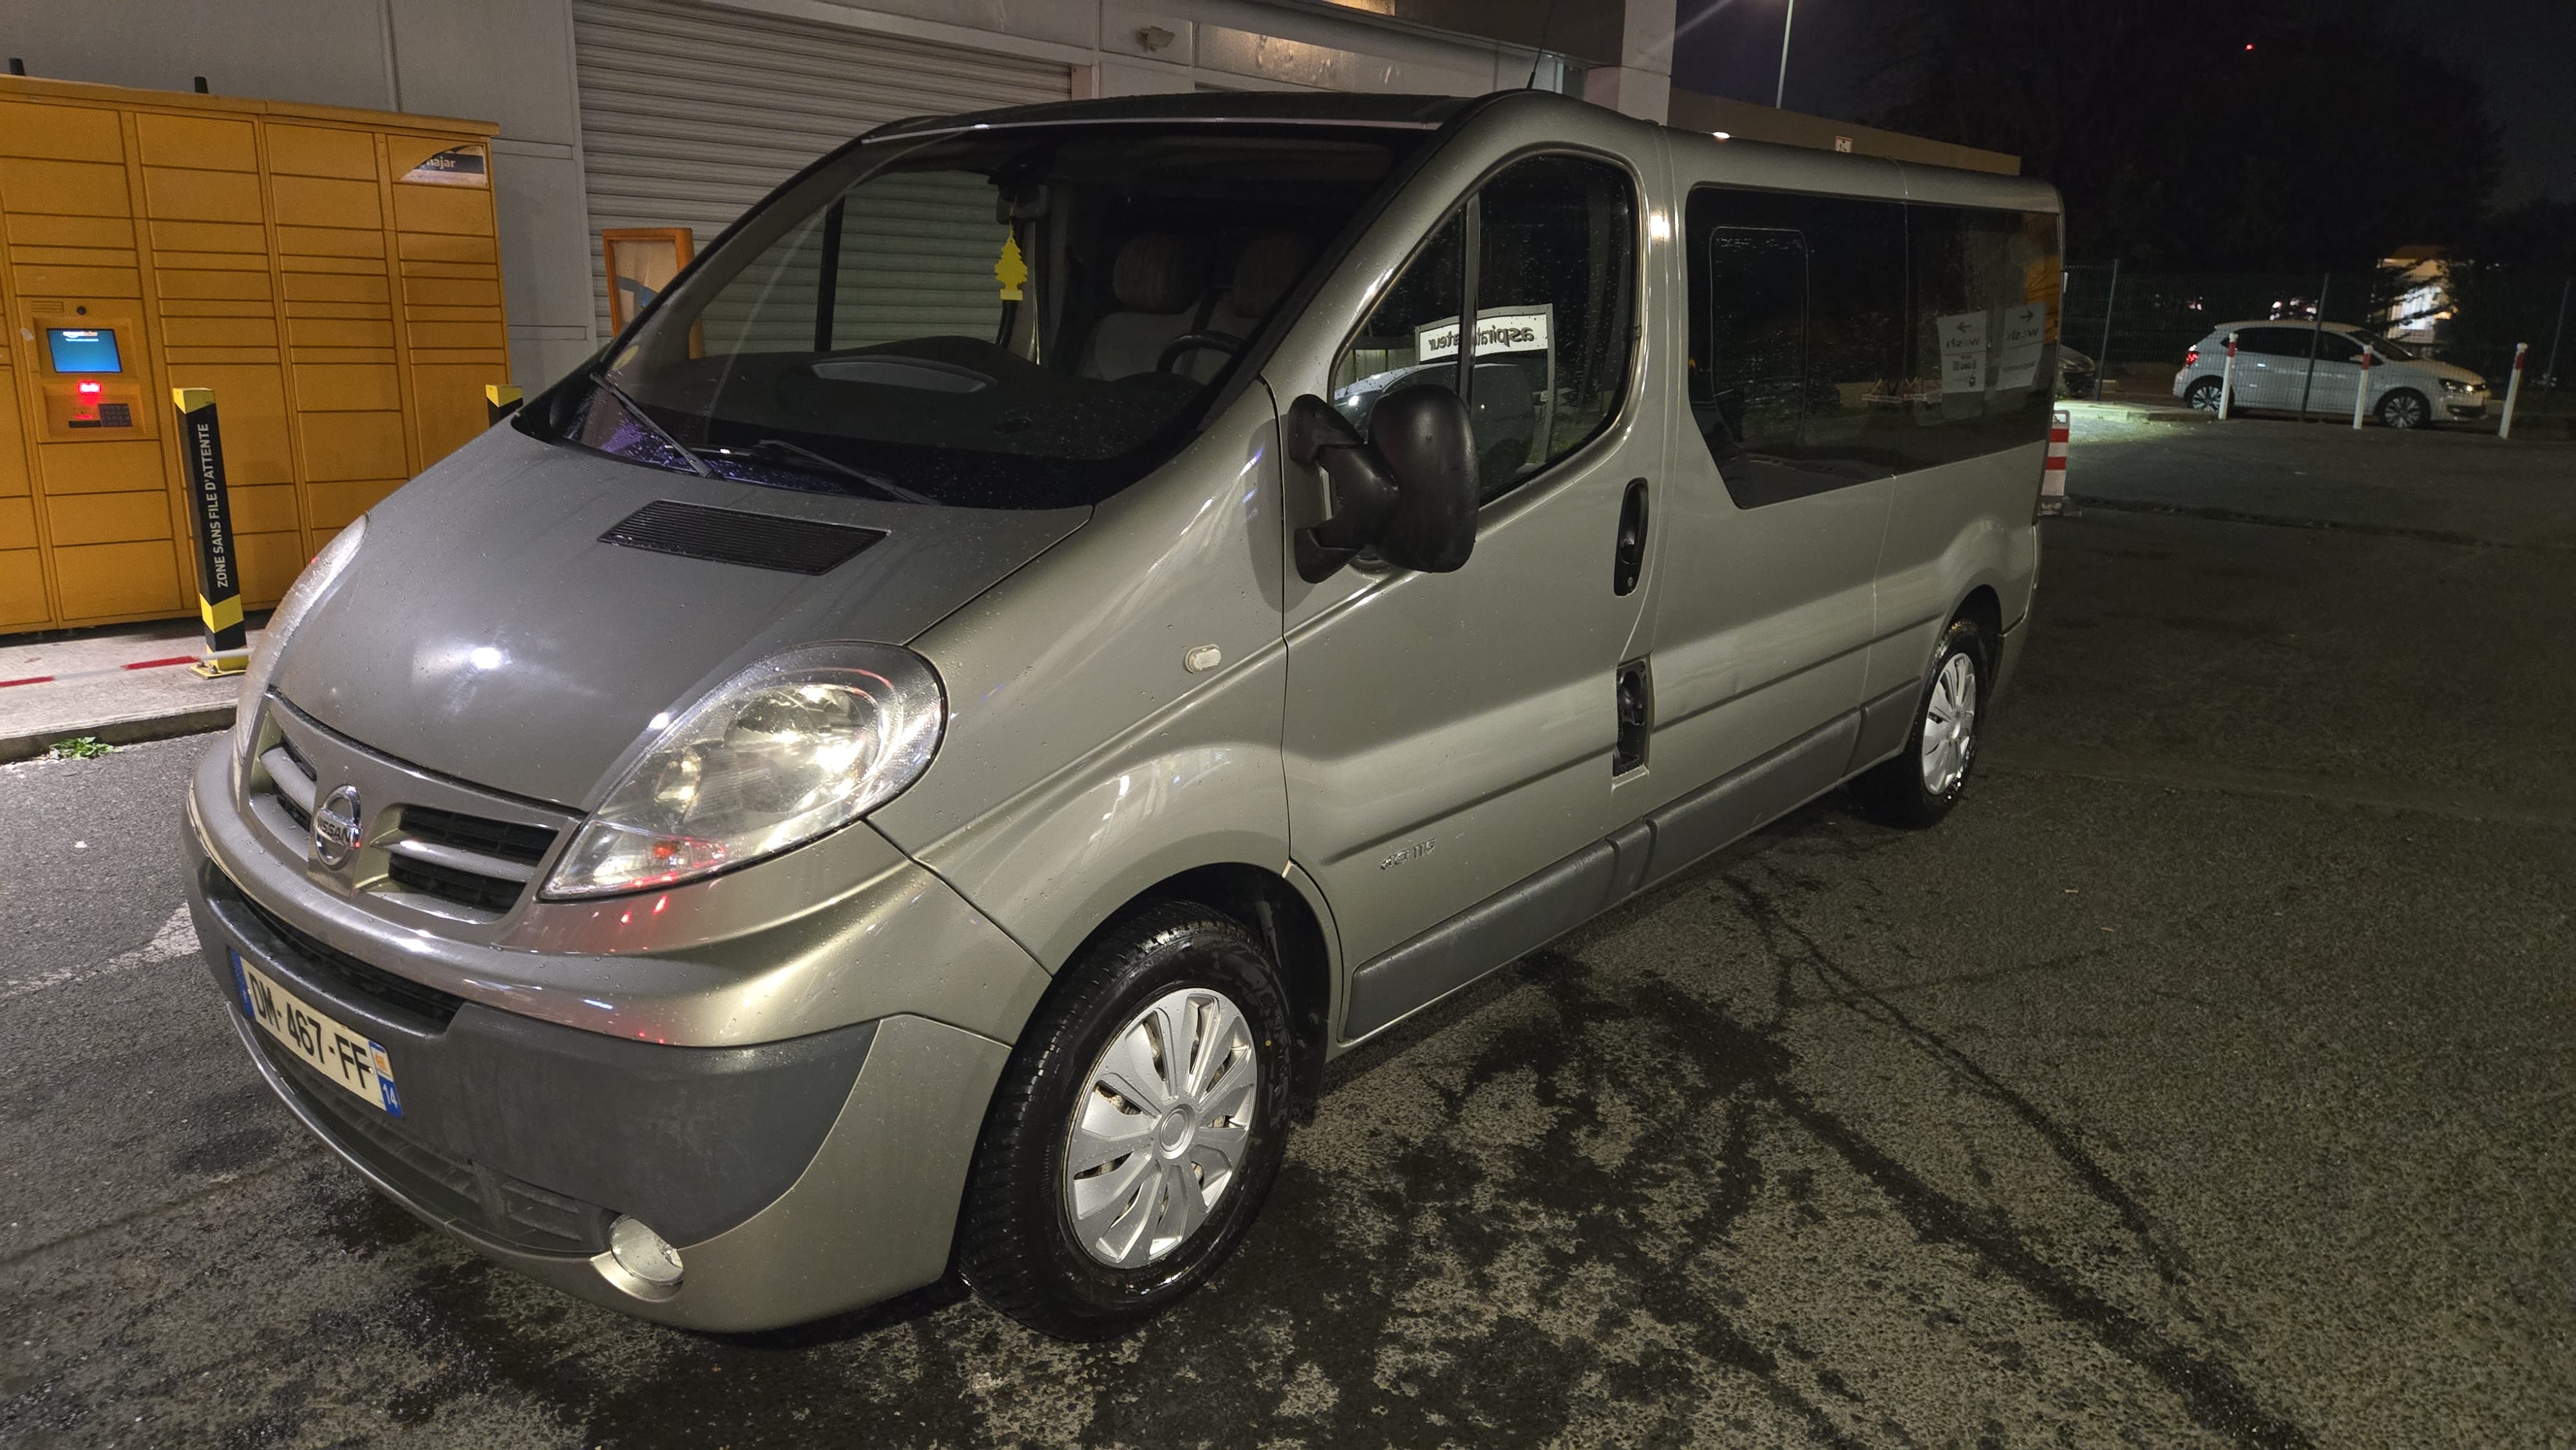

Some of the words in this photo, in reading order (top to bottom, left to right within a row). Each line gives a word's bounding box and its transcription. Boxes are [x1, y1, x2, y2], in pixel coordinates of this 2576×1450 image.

[197, 423, 214, 491] D'ATTENTE
[207, 492, 220, 520] FILE
[211, 521, 225, 554] SANS
[214, 556, 229, 587] ZONE
[383, 1083, 398, 1109] 14
